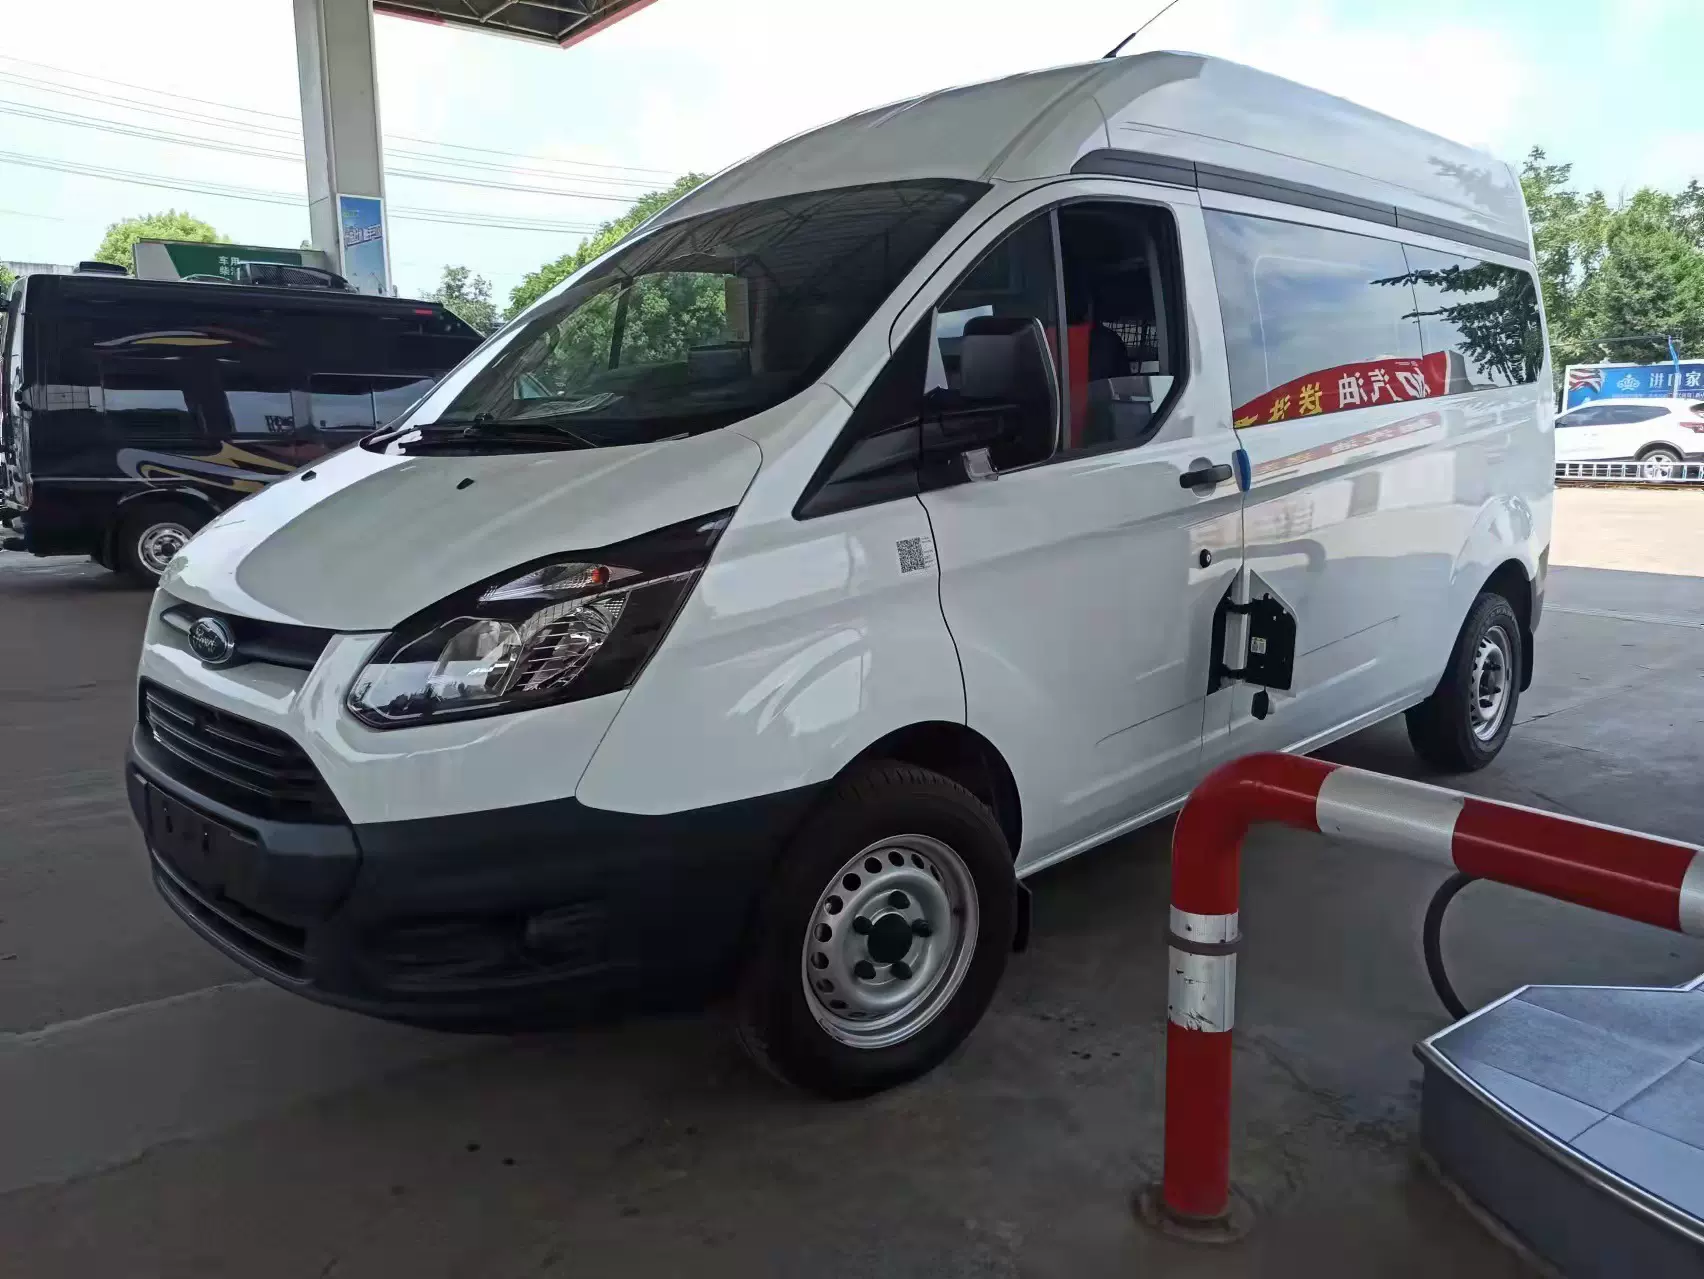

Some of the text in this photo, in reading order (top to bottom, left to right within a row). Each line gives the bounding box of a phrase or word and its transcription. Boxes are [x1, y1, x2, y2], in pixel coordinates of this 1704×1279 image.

[218, 256, 240, 266] 车用
[1649, 371, 1704, 388] 进口家
